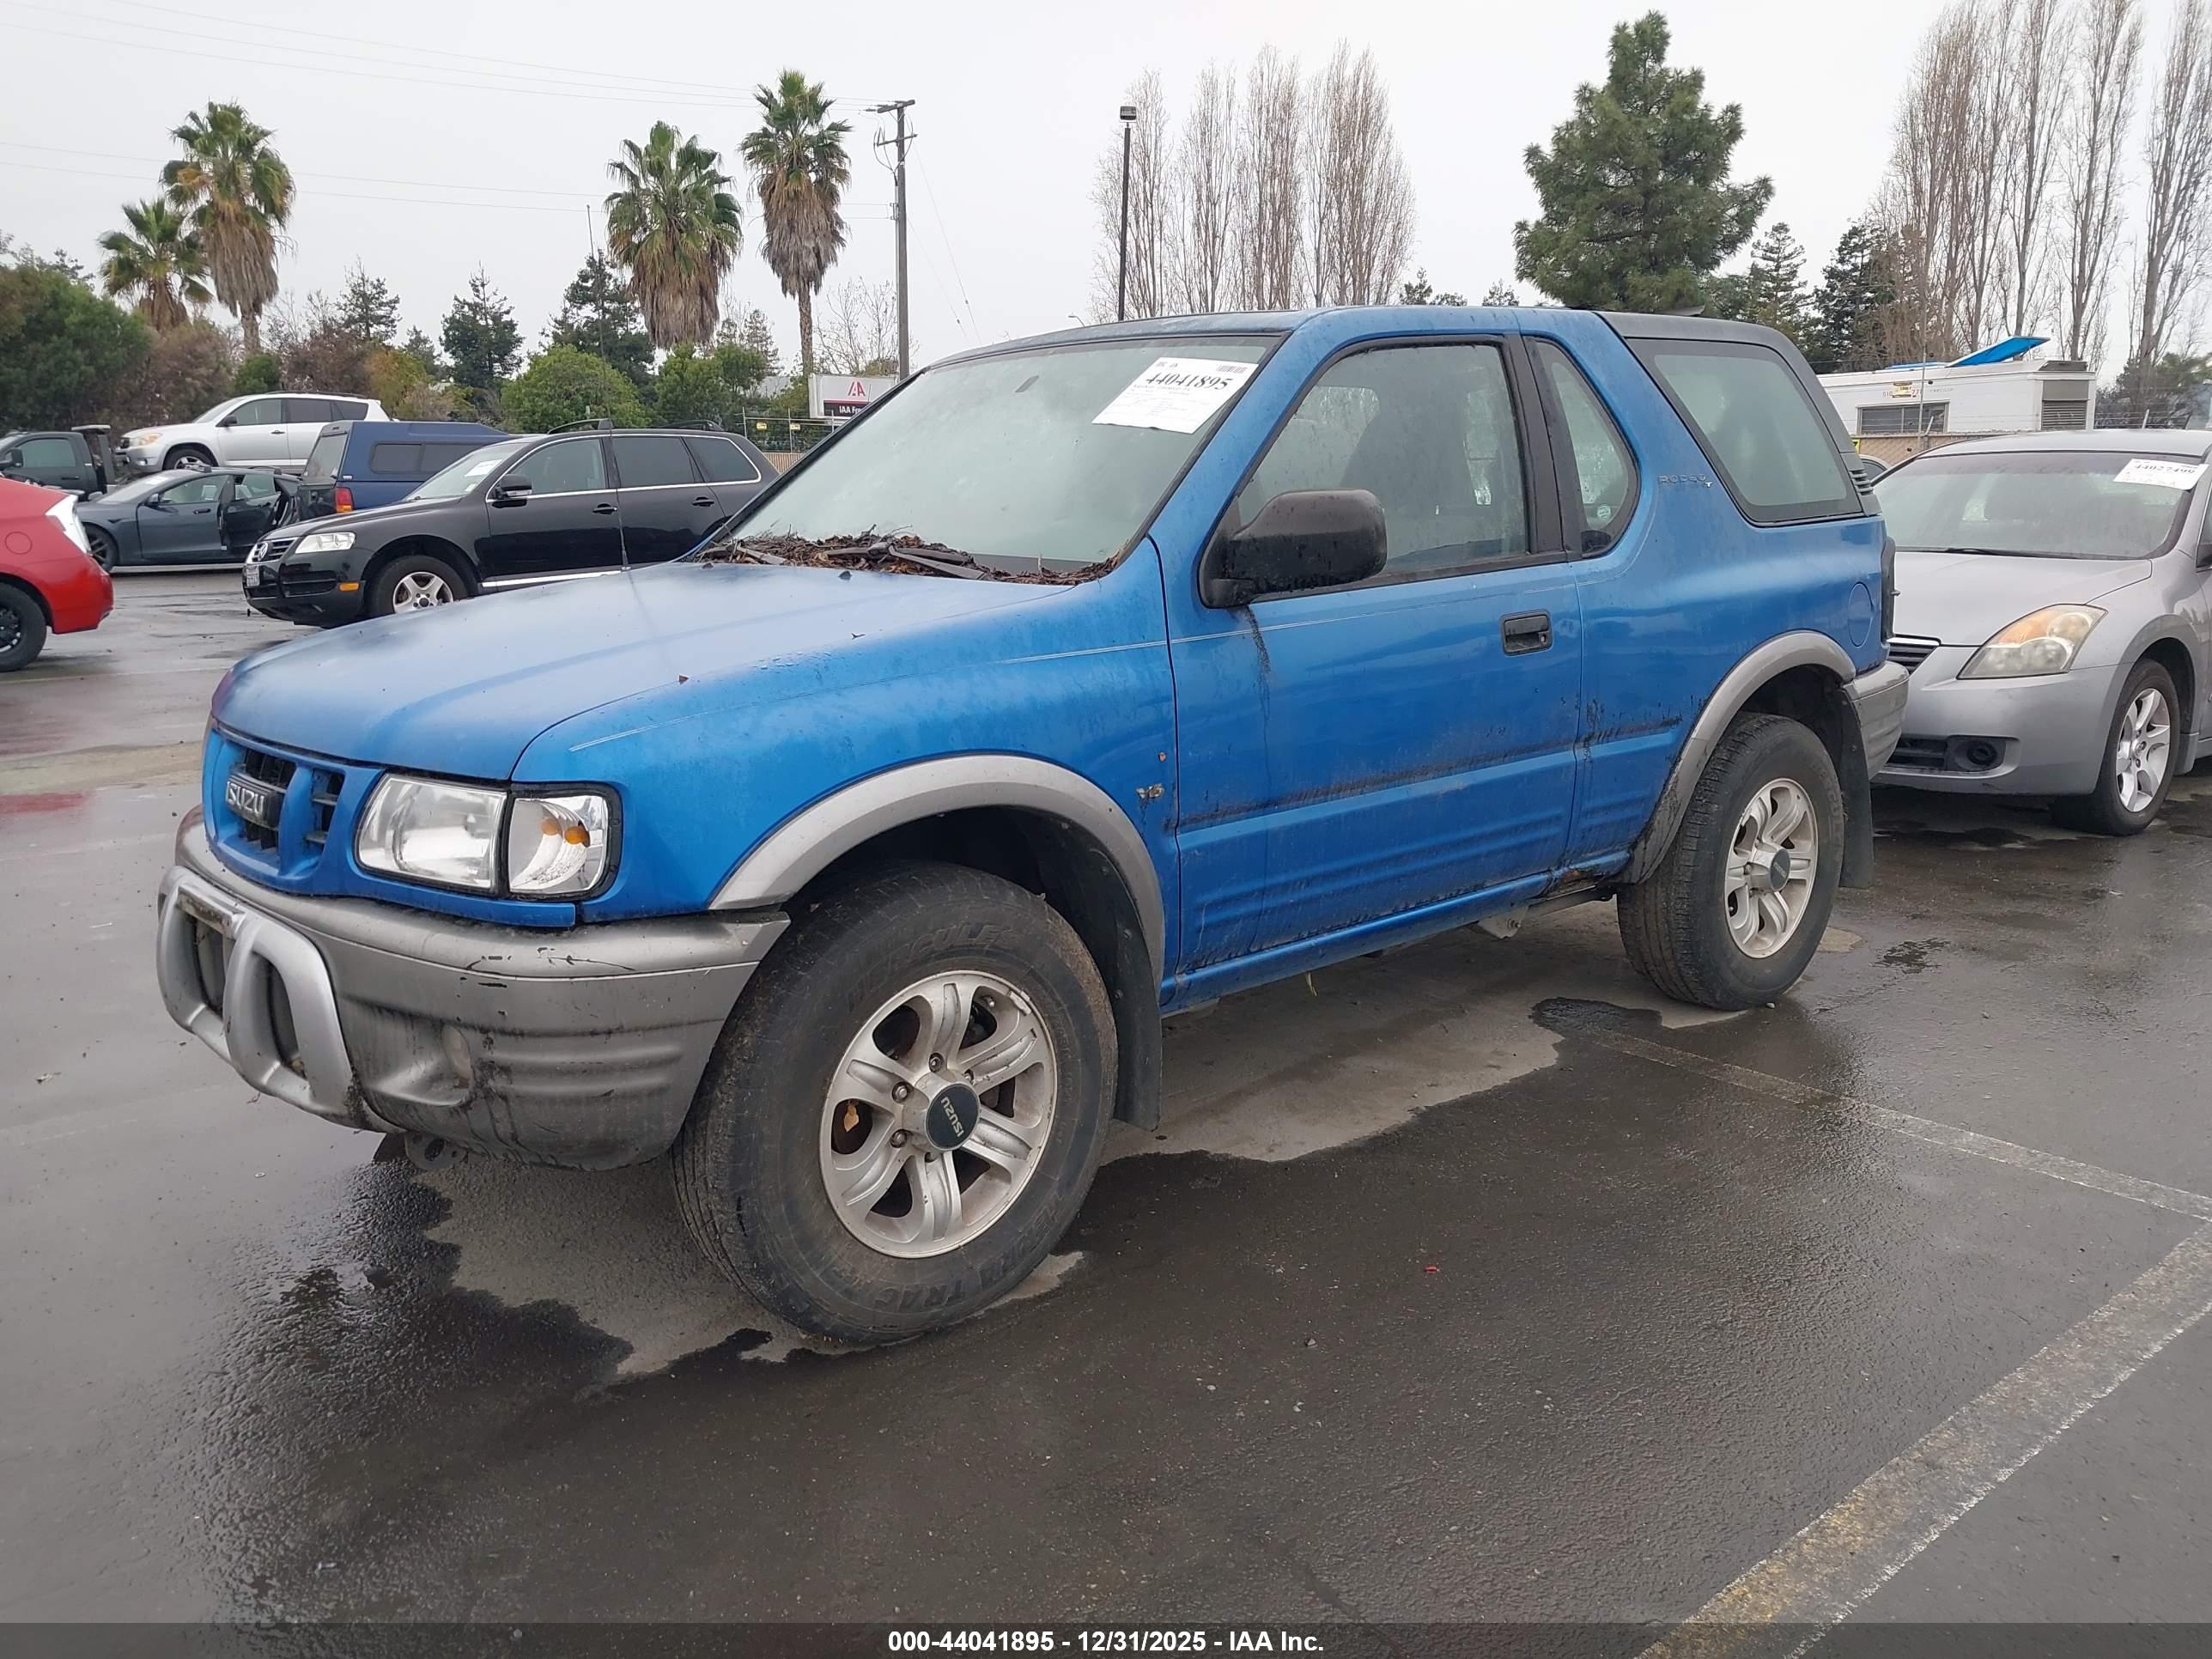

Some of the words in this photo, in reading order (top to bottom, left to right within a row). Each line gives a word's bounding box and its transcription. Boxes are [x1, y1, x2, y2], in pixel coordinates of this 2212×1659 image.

[1146, 372, 1234, 390] 44041895
[839, 405, 852, 414] IAA
[1657, 473, 1706, 483] RODEO
[225, 781, 265, 817] ISUZU
[940, 1097, 964, 1137] ISUZU
